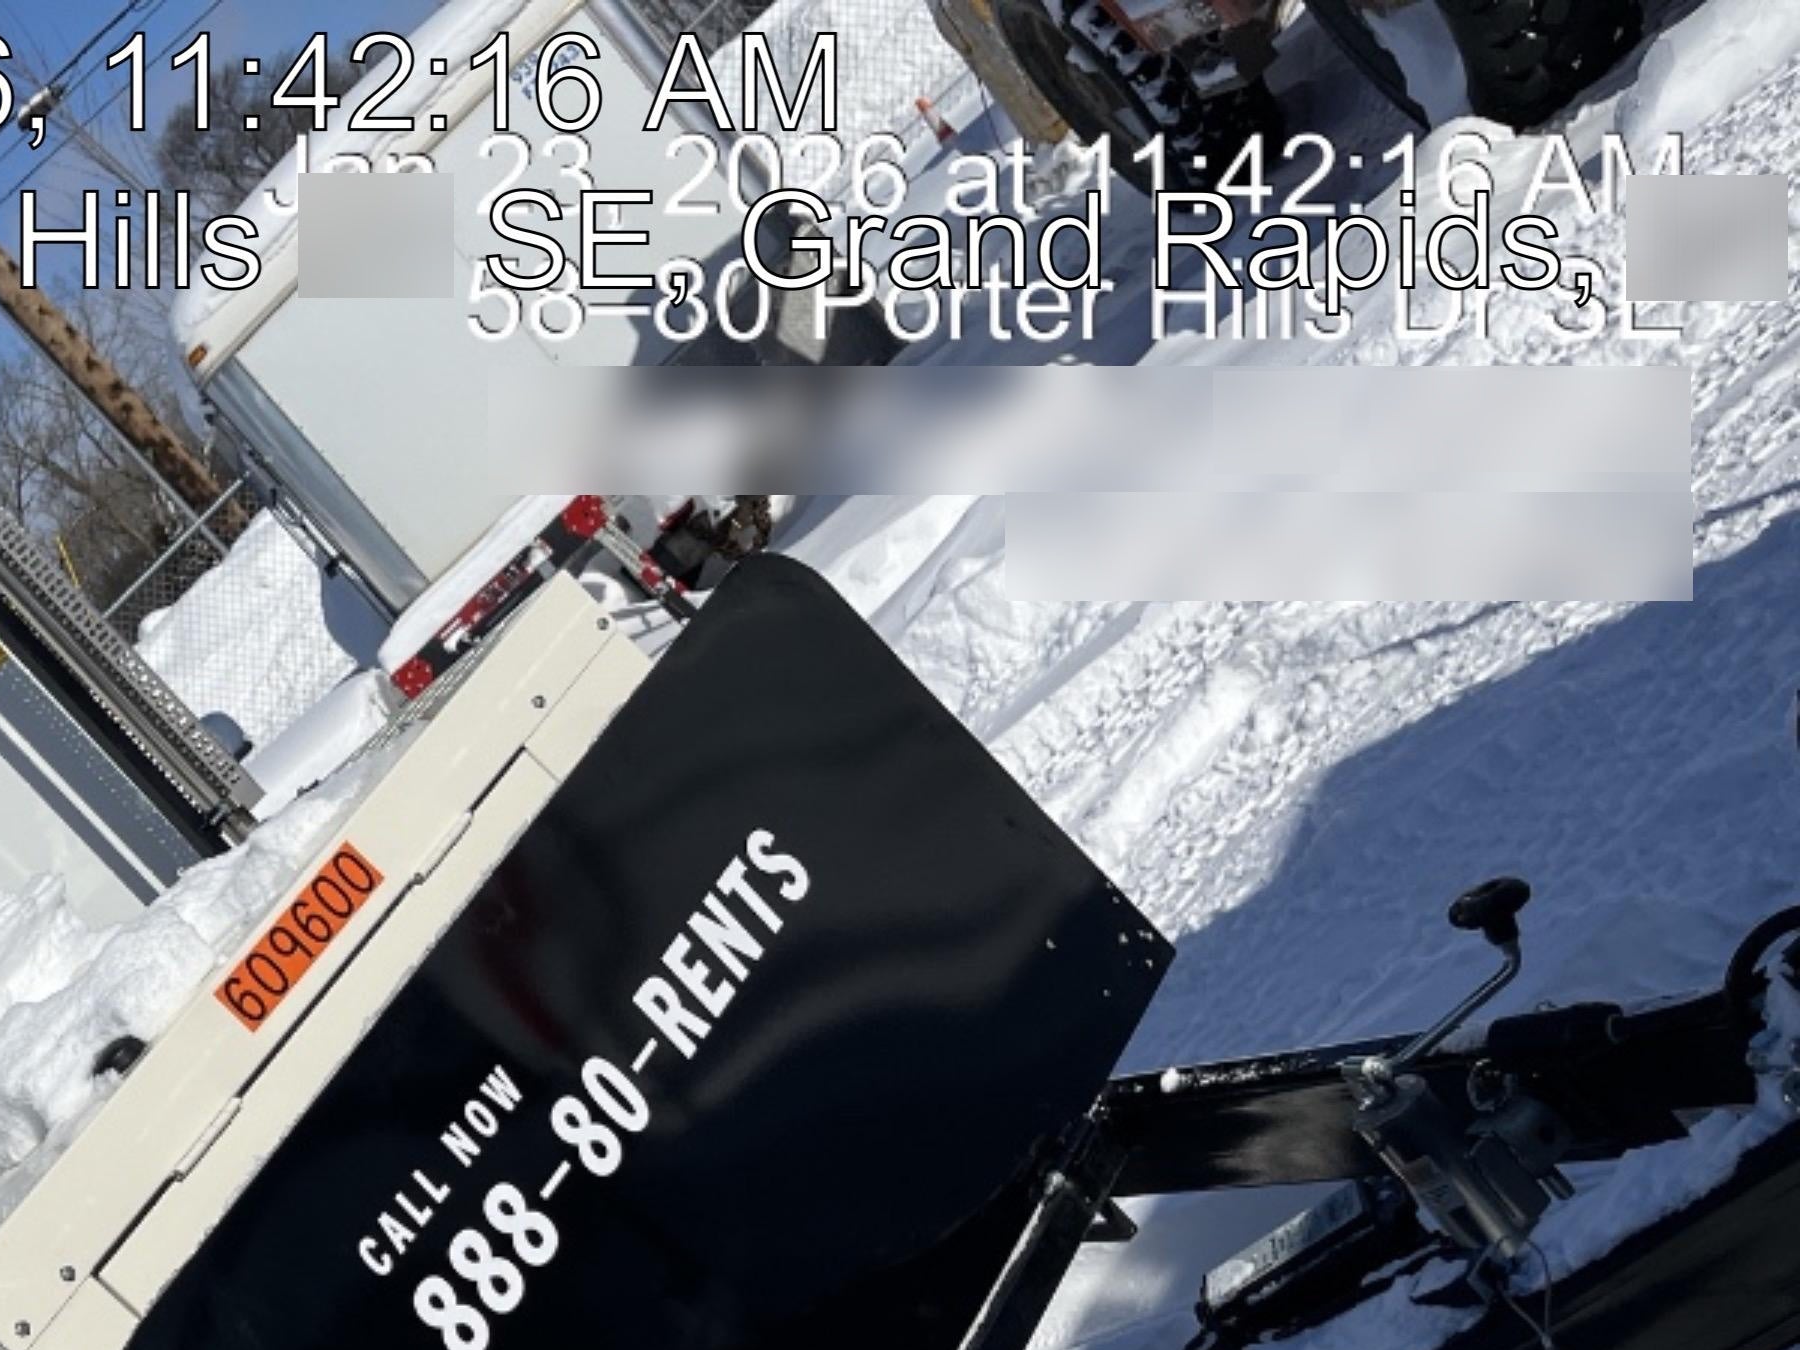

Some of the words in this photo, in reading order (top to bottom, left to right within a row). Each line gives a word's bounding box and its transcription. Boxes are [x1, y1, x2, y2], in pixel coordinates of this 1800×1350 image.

[223, 851, 376, 1021] 609600
[357, 1168, 452, 1276] CALL
[439, 1063, 524, 1168] NOW
